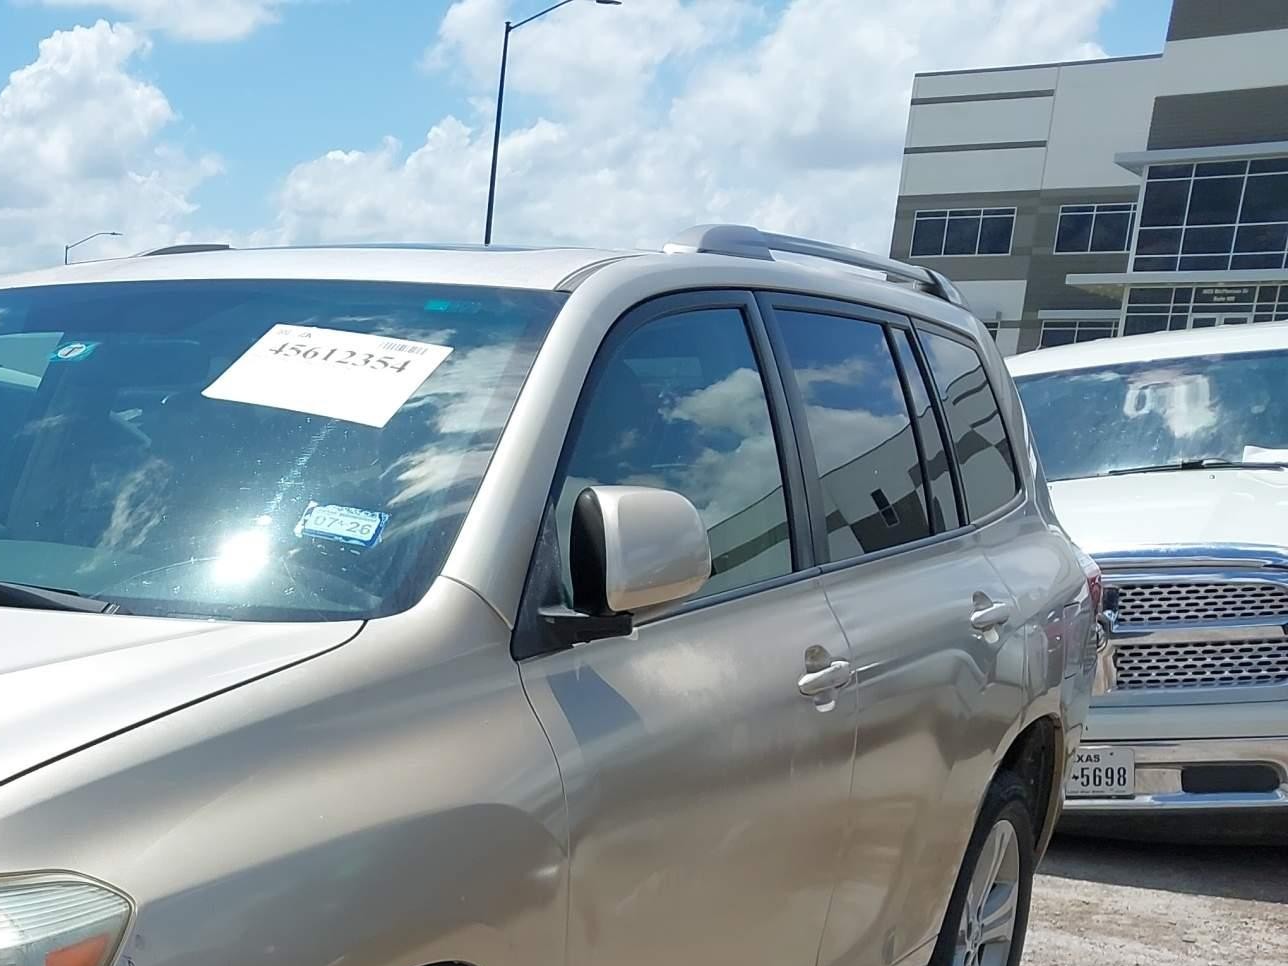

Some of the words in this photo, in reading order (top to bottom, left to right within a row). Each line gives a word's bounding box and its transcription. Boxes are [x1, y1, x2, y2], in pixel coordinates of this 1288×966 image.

[268, 342, 412, 373] 45612354
[313, 515, 340, 528] 07
[346, 521, 372, 535] 26
[1076, 754, 1100, 763] XAS
